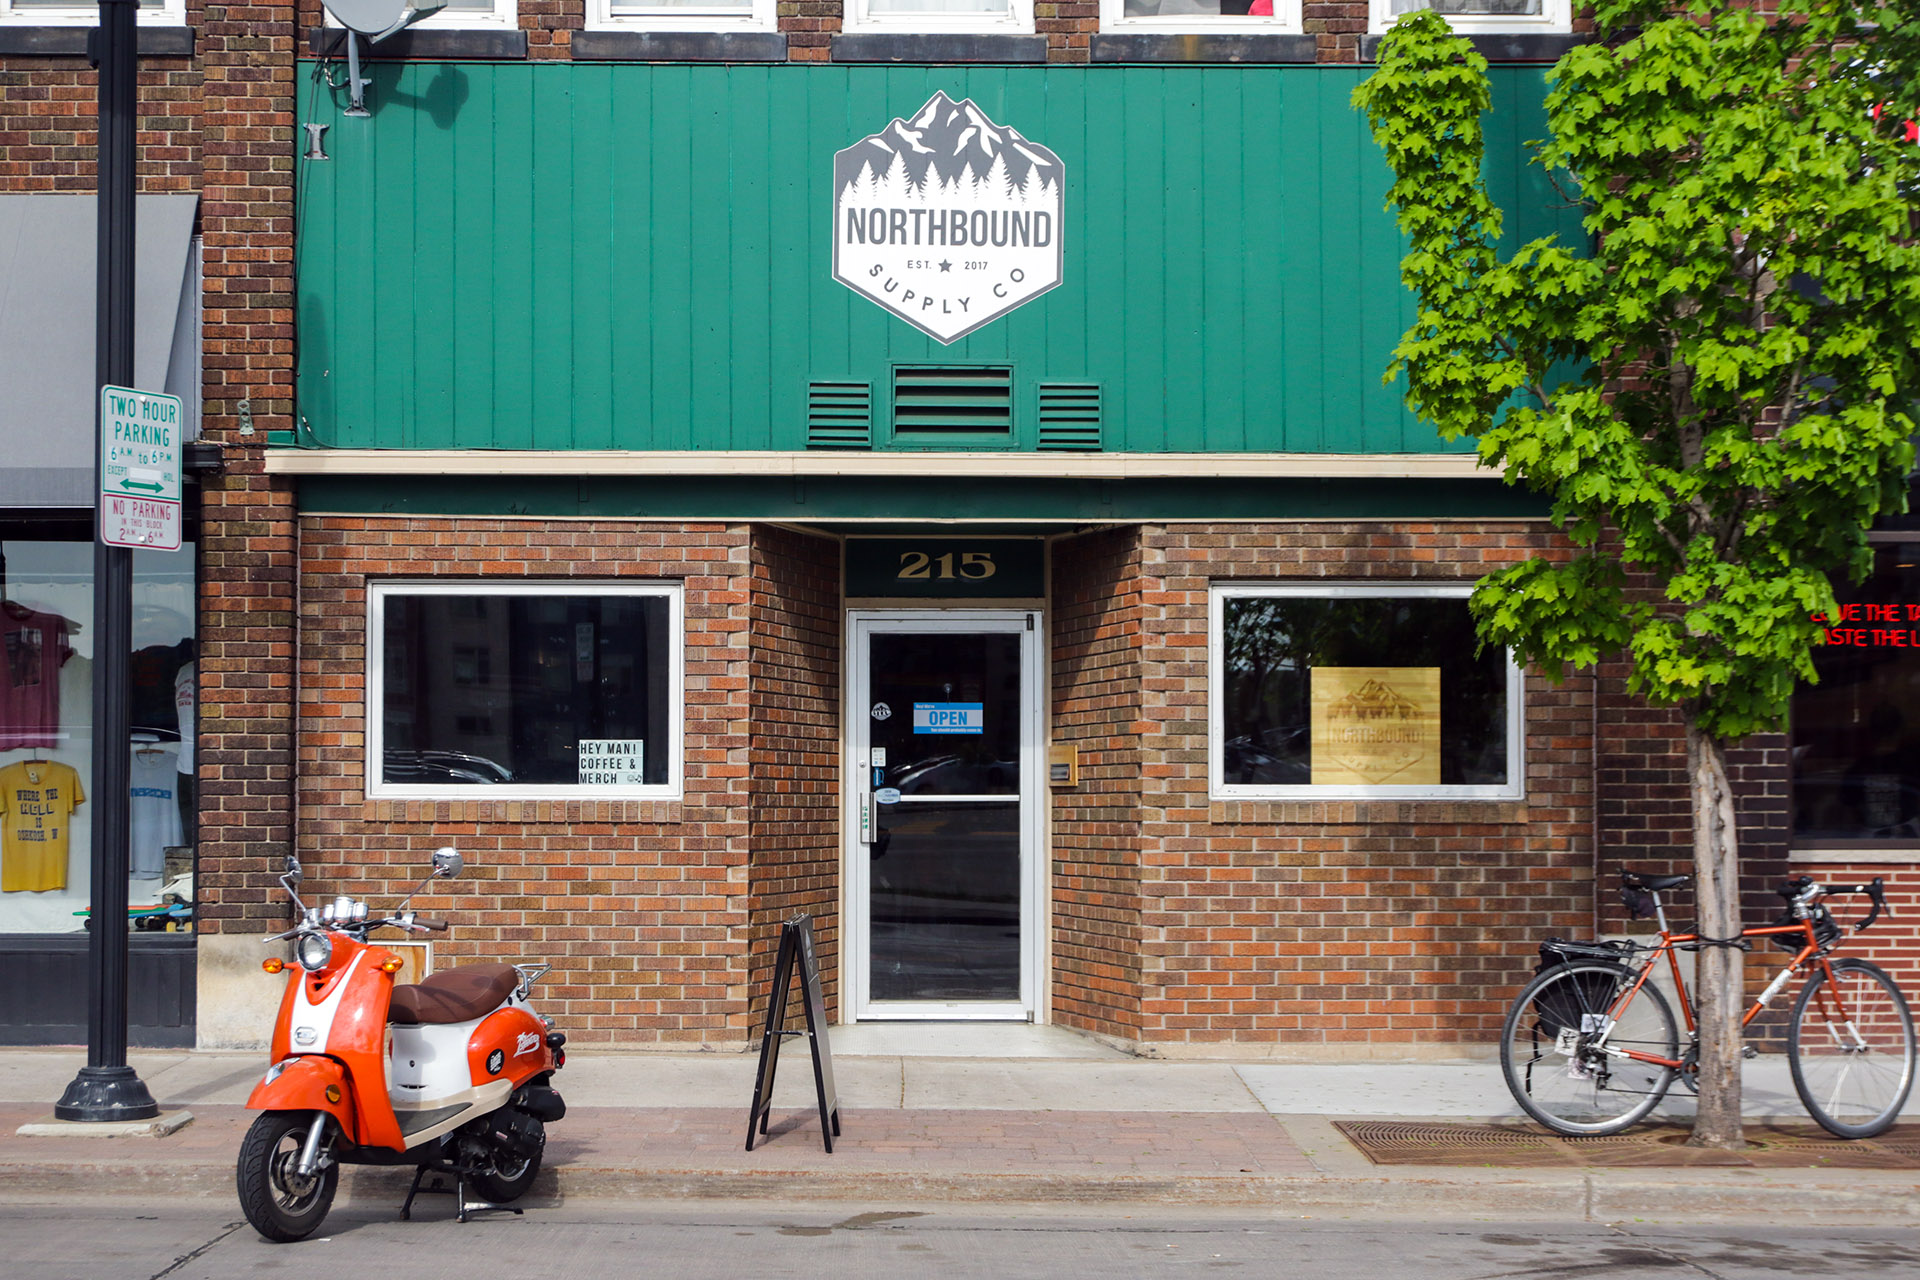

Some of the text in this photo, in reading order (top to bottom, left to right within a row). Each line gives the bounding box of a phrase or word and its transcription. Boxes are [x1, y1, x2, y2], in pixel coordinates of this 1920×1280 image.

[847, 207, 1052, 248] NORTHBOUND
[907, 260, 988, 270] EST. 2017
[869, 264, 1025, 314] SUPPLY CO
[109, 395, 176, 424] TWO HOUR
[115, 420, 170, 447] PARKING
[111, 446, 117, 461] 6
[138, 453, 148, 465] to
[152, 450, 158, 464] 6
[107, 464, 128, 476] EXCEPT
[113, 499, 171, 521] NO PARKING
[121, 518, 163, 529] IN THIS BLOCK
[119, 528, 126, 541] 2
[148, 531, 154, 543] 6
[897, 551, 997, 582] 215
[1864, 603, 1901, 622] THE
[1818, 628, 1868, 647] STE
[1870, 629, 1908, 647] THE
[928, 710, 968, 726] OPEN
[1332, 727, 1419, 744] NORTHBOUND
[580, 743, 637, 755] HEY MAN!
[580, 757, 636, 770] COFFEE &
[580, 772, 617, 784] MERCH
[16, 788, 58, 802] WHERE THE
[20, 803, 55, 816] HELL
[35, 817, 42, 828] IS
